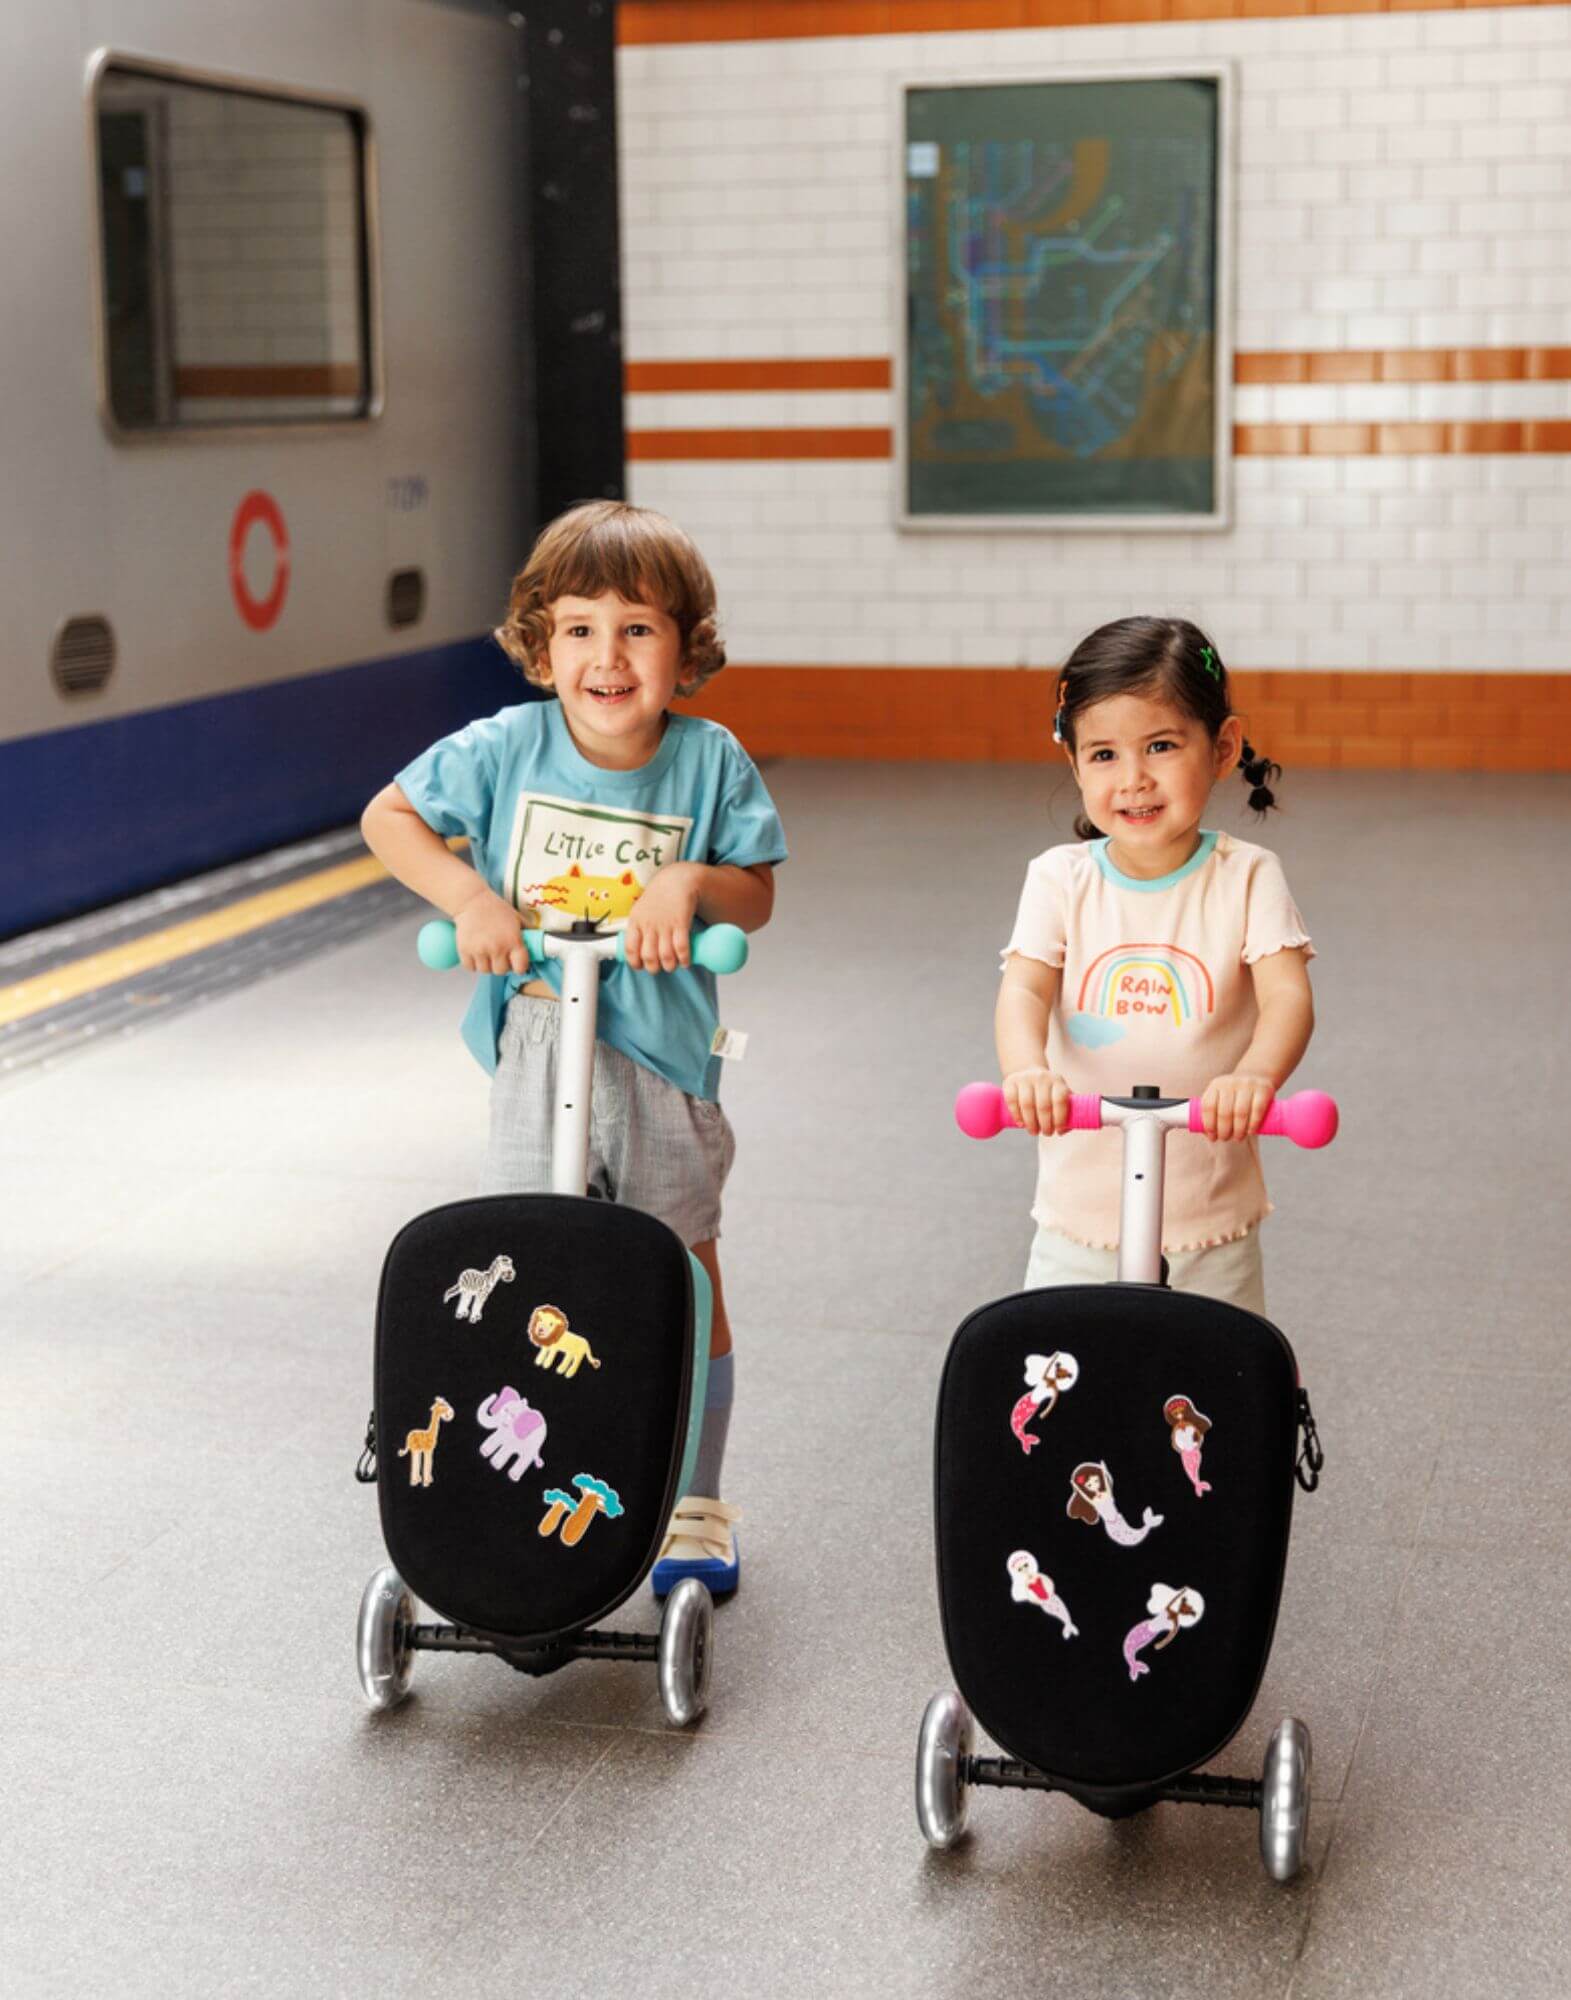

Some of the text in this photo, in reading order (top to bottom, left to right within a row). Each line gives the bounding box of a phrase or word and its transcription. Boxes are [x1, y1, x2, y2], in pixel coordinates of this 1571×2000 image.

[615, 840, 664, 866] Cat
[1120, 975, 1172, 996] RAIN
[1116, 999, 1168, 1015] BOW
